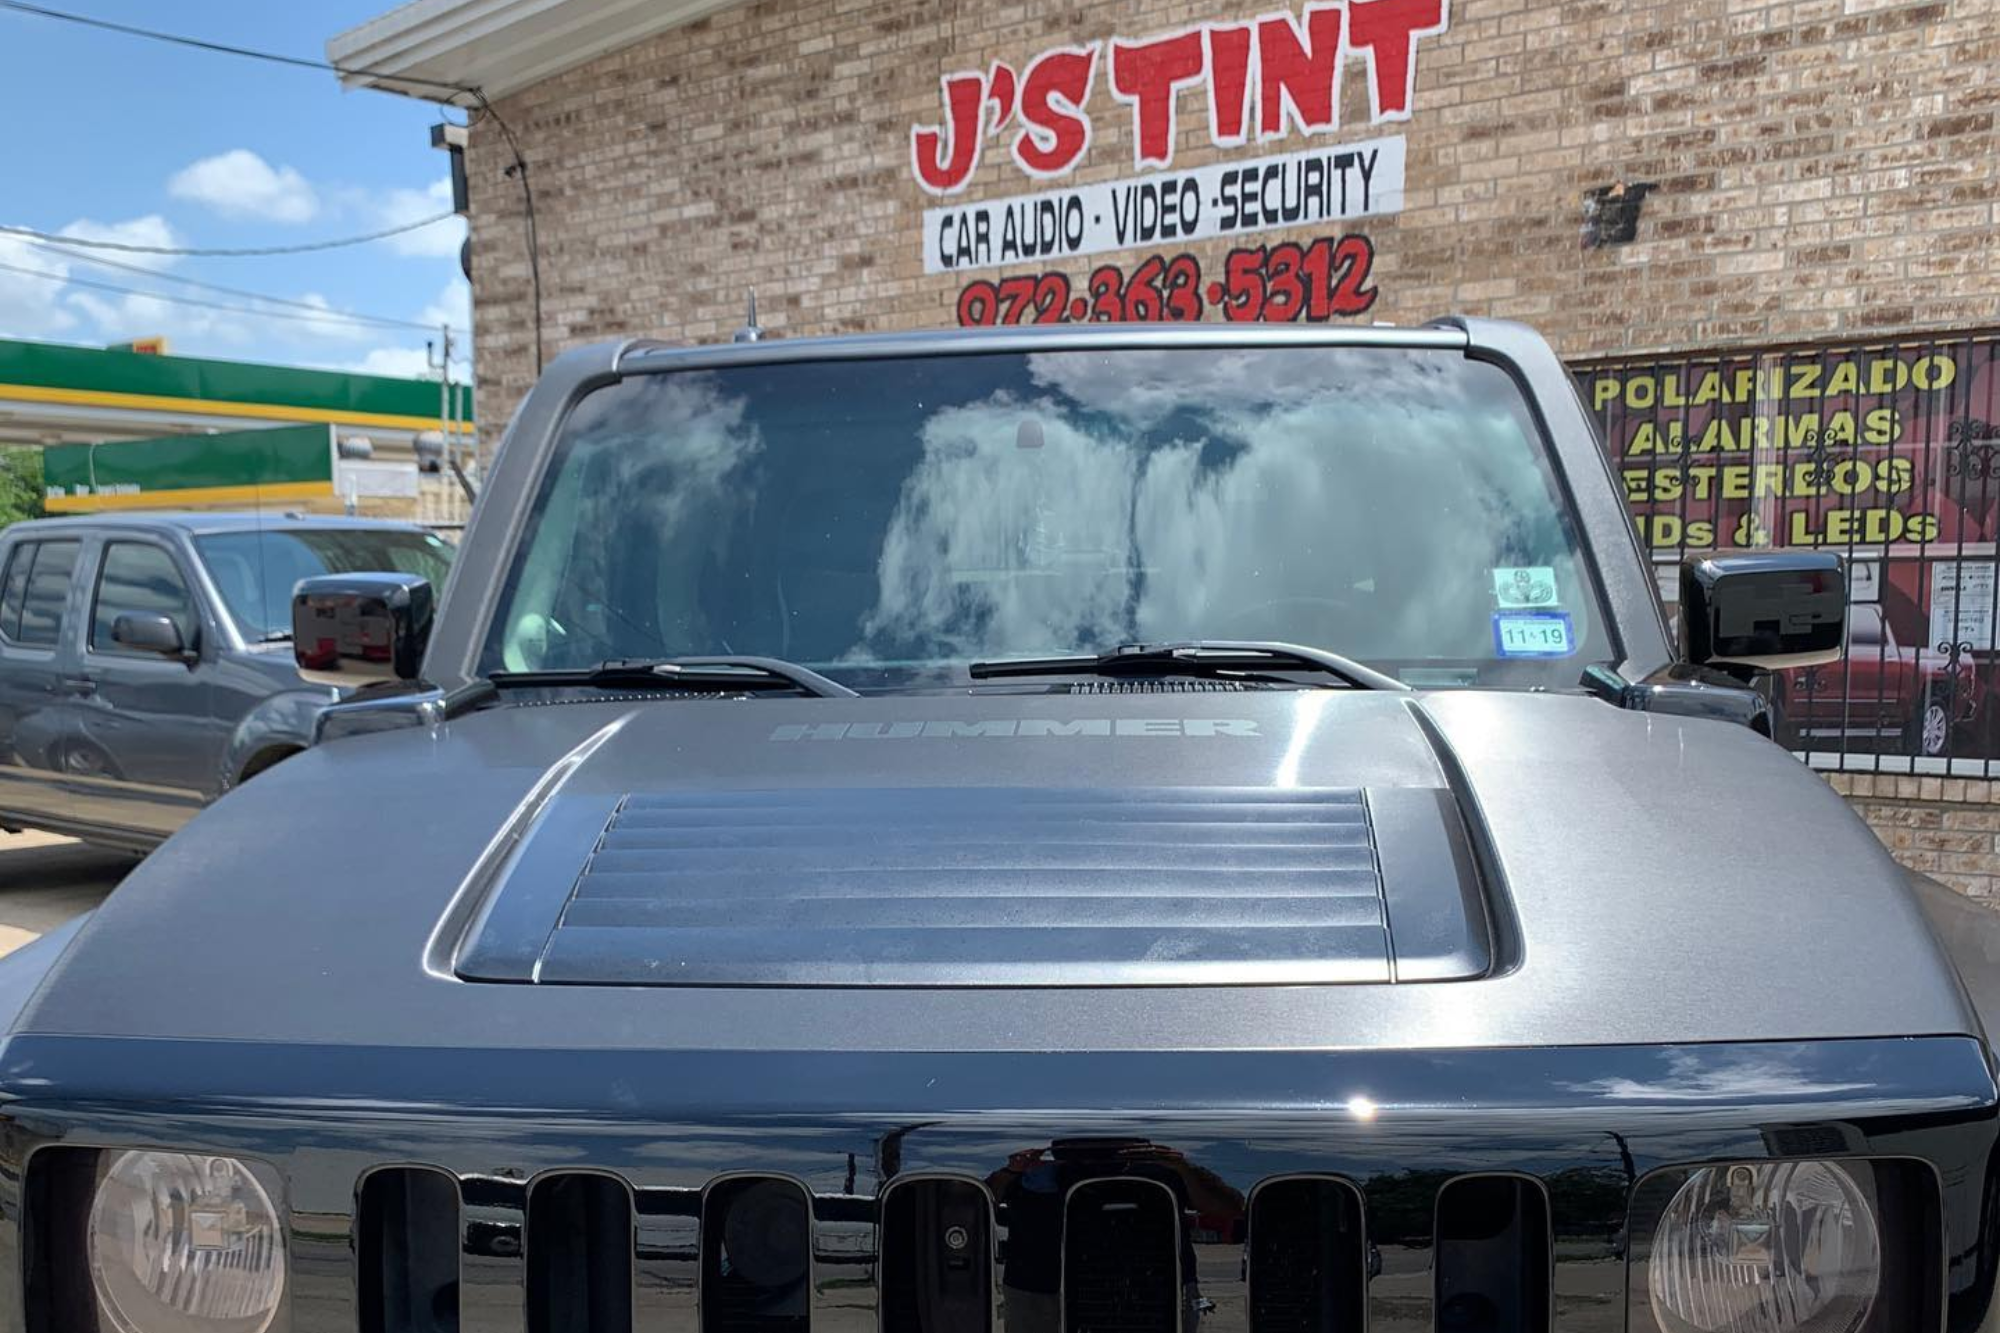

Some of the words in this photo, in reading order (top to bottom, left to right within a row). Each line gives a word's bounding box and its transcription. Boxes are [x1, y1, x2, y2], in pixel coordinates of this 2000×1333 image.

[911, 44, 1099, 194] J'S
[1106, 0, 1450, 168] TINT
[938, 213, 991, 268] CAR
[1001, 197, 1084, 261] AUDIO
[1111, 177, 1200, 245] VIDEO
[1217, 149, 1379, 231] SECURITY
[1594, 355, 1957, 411] POLARIZADO
[1629, 409, 1902, 455] ALARMAS
[1623, 457, 1913, 502] ESTEREOS
[1734, 512, 1769, 547] &
[1791, 508, 1940, 547] LEDs
[769, 719, 1263, 741] HUMMER
